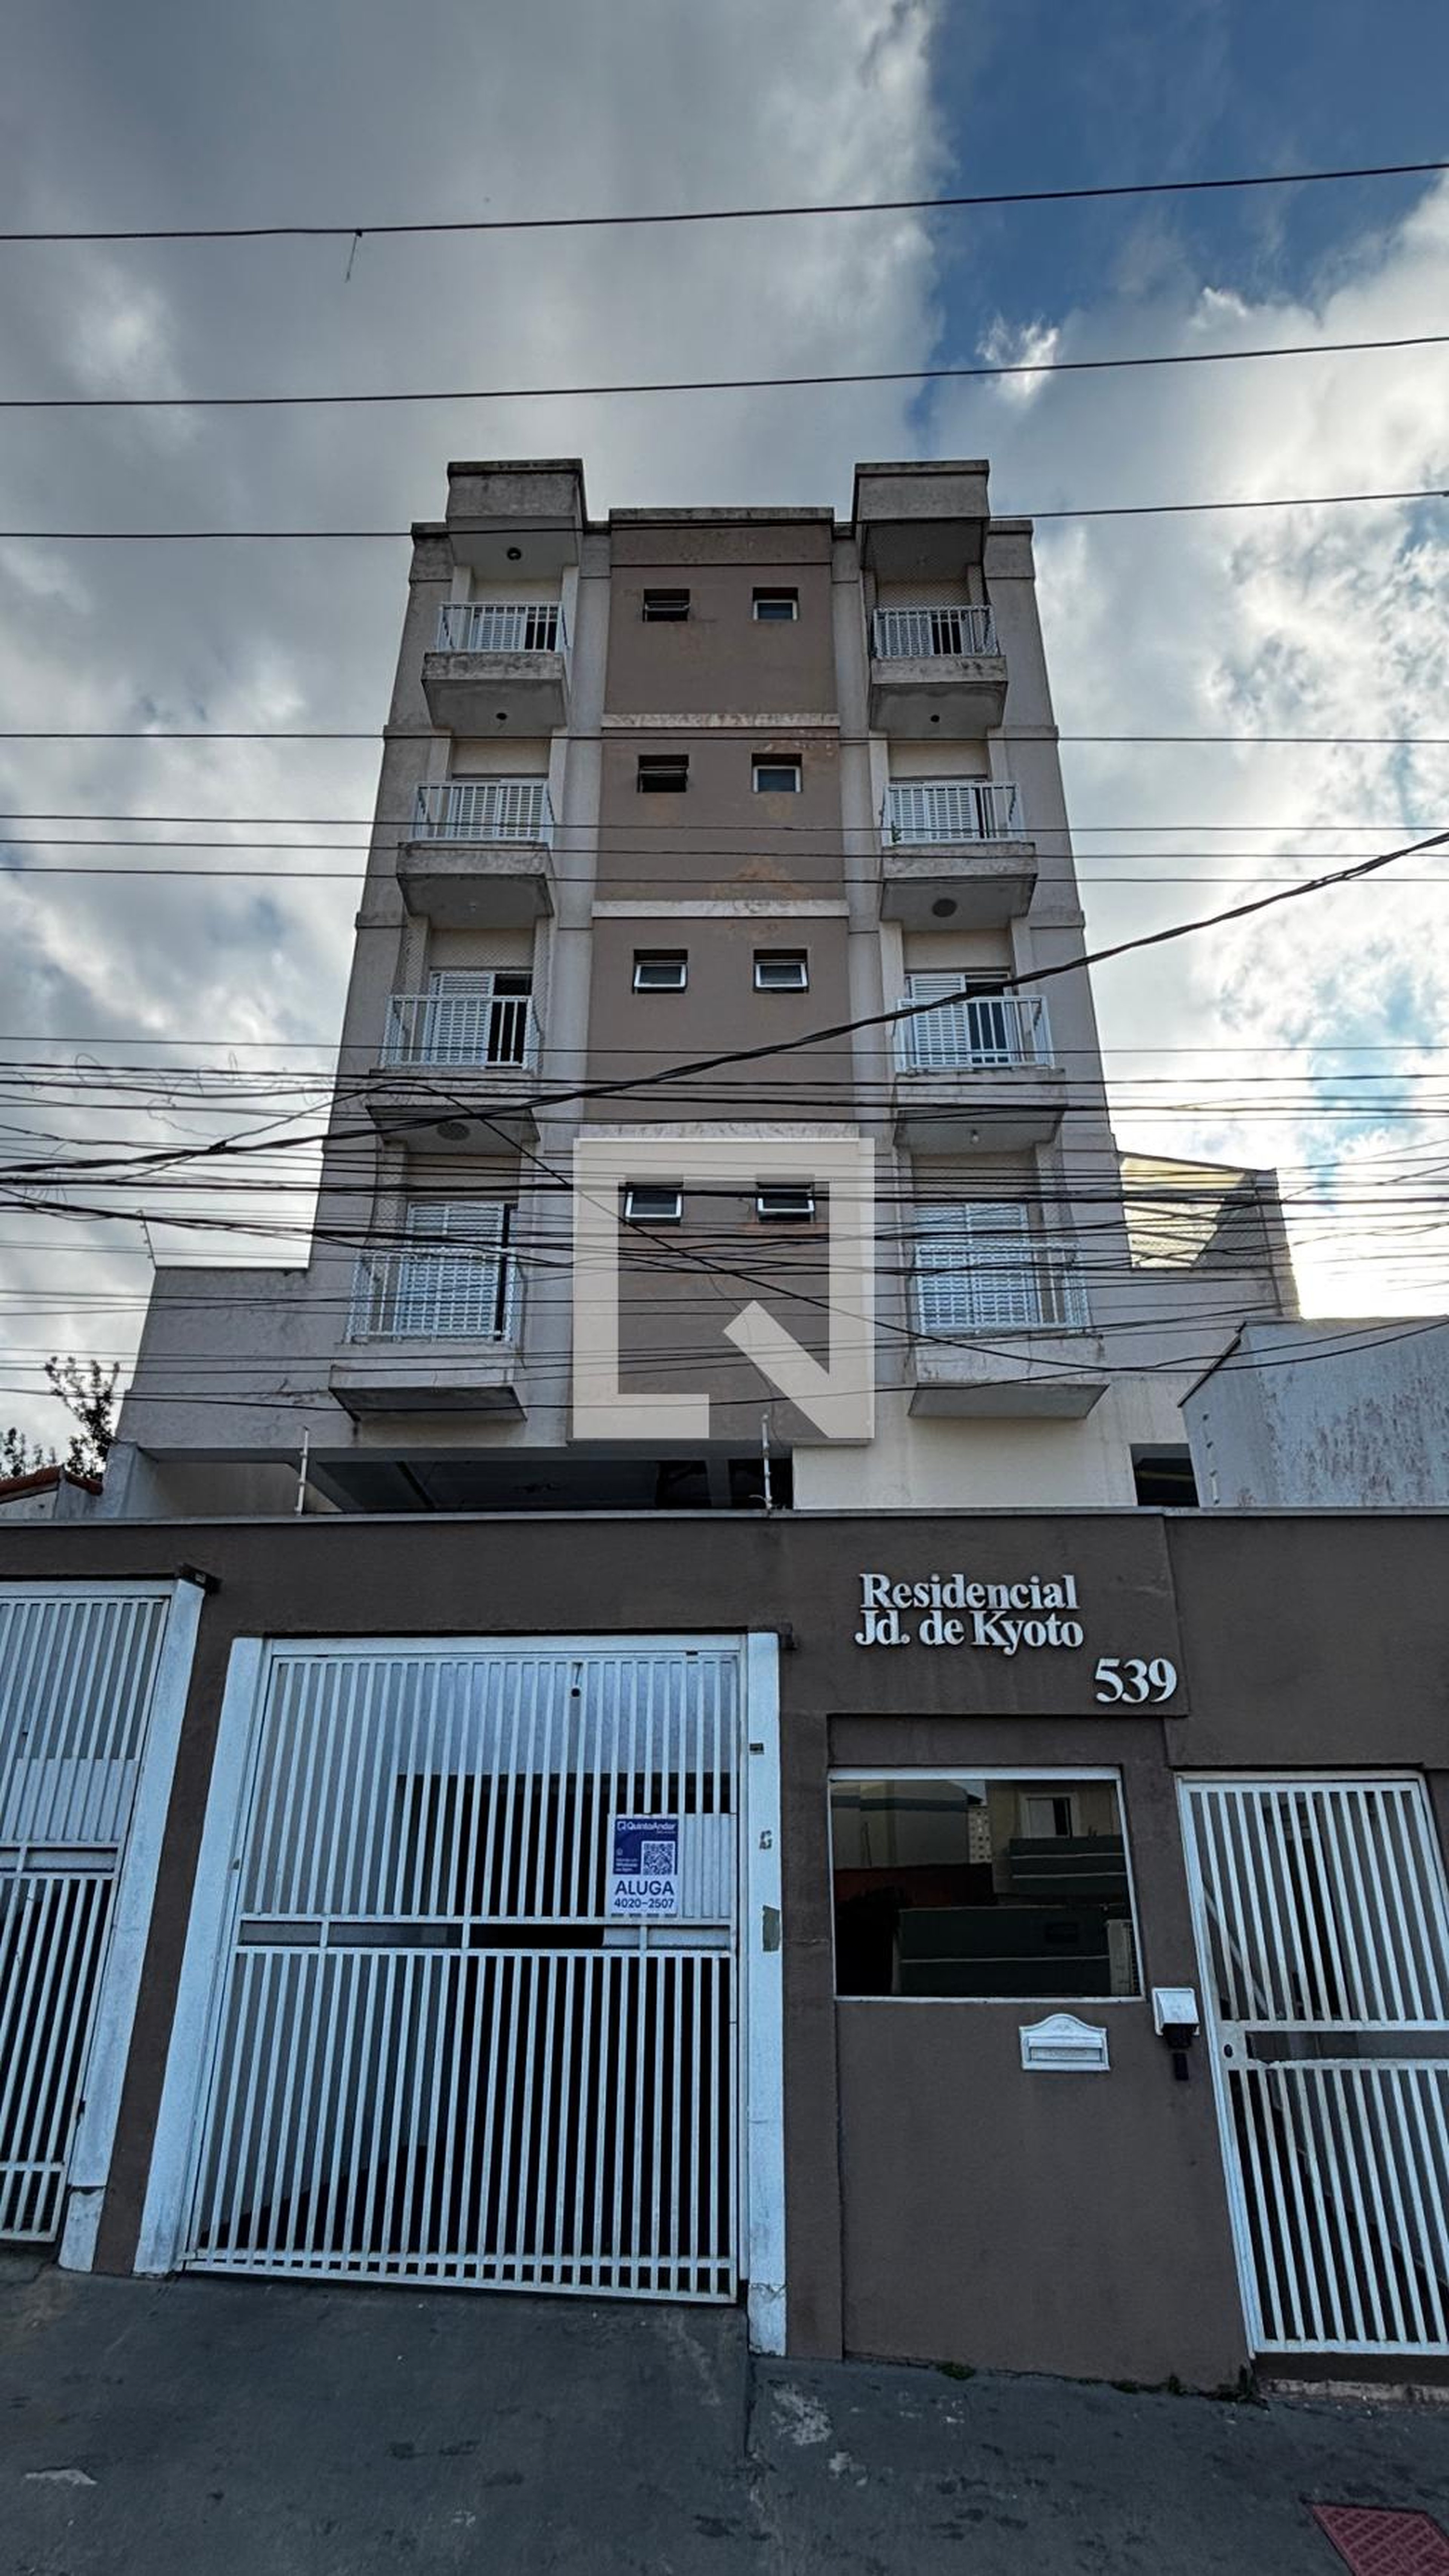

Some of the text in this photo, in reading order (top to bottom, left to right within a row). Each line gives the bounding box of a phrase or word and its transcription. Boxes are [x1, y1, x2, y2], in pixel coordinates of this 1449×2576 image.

[859, 1573, 1080, 1609] Residencial
[854, 1610, 1084, 1655] Jd. de Kyoto
[1094, 1658, 1177, 1703] 539
[614, 1880, 674, 1895] ALUGA
[614, 1898, 674, 1909] 4020-2507
